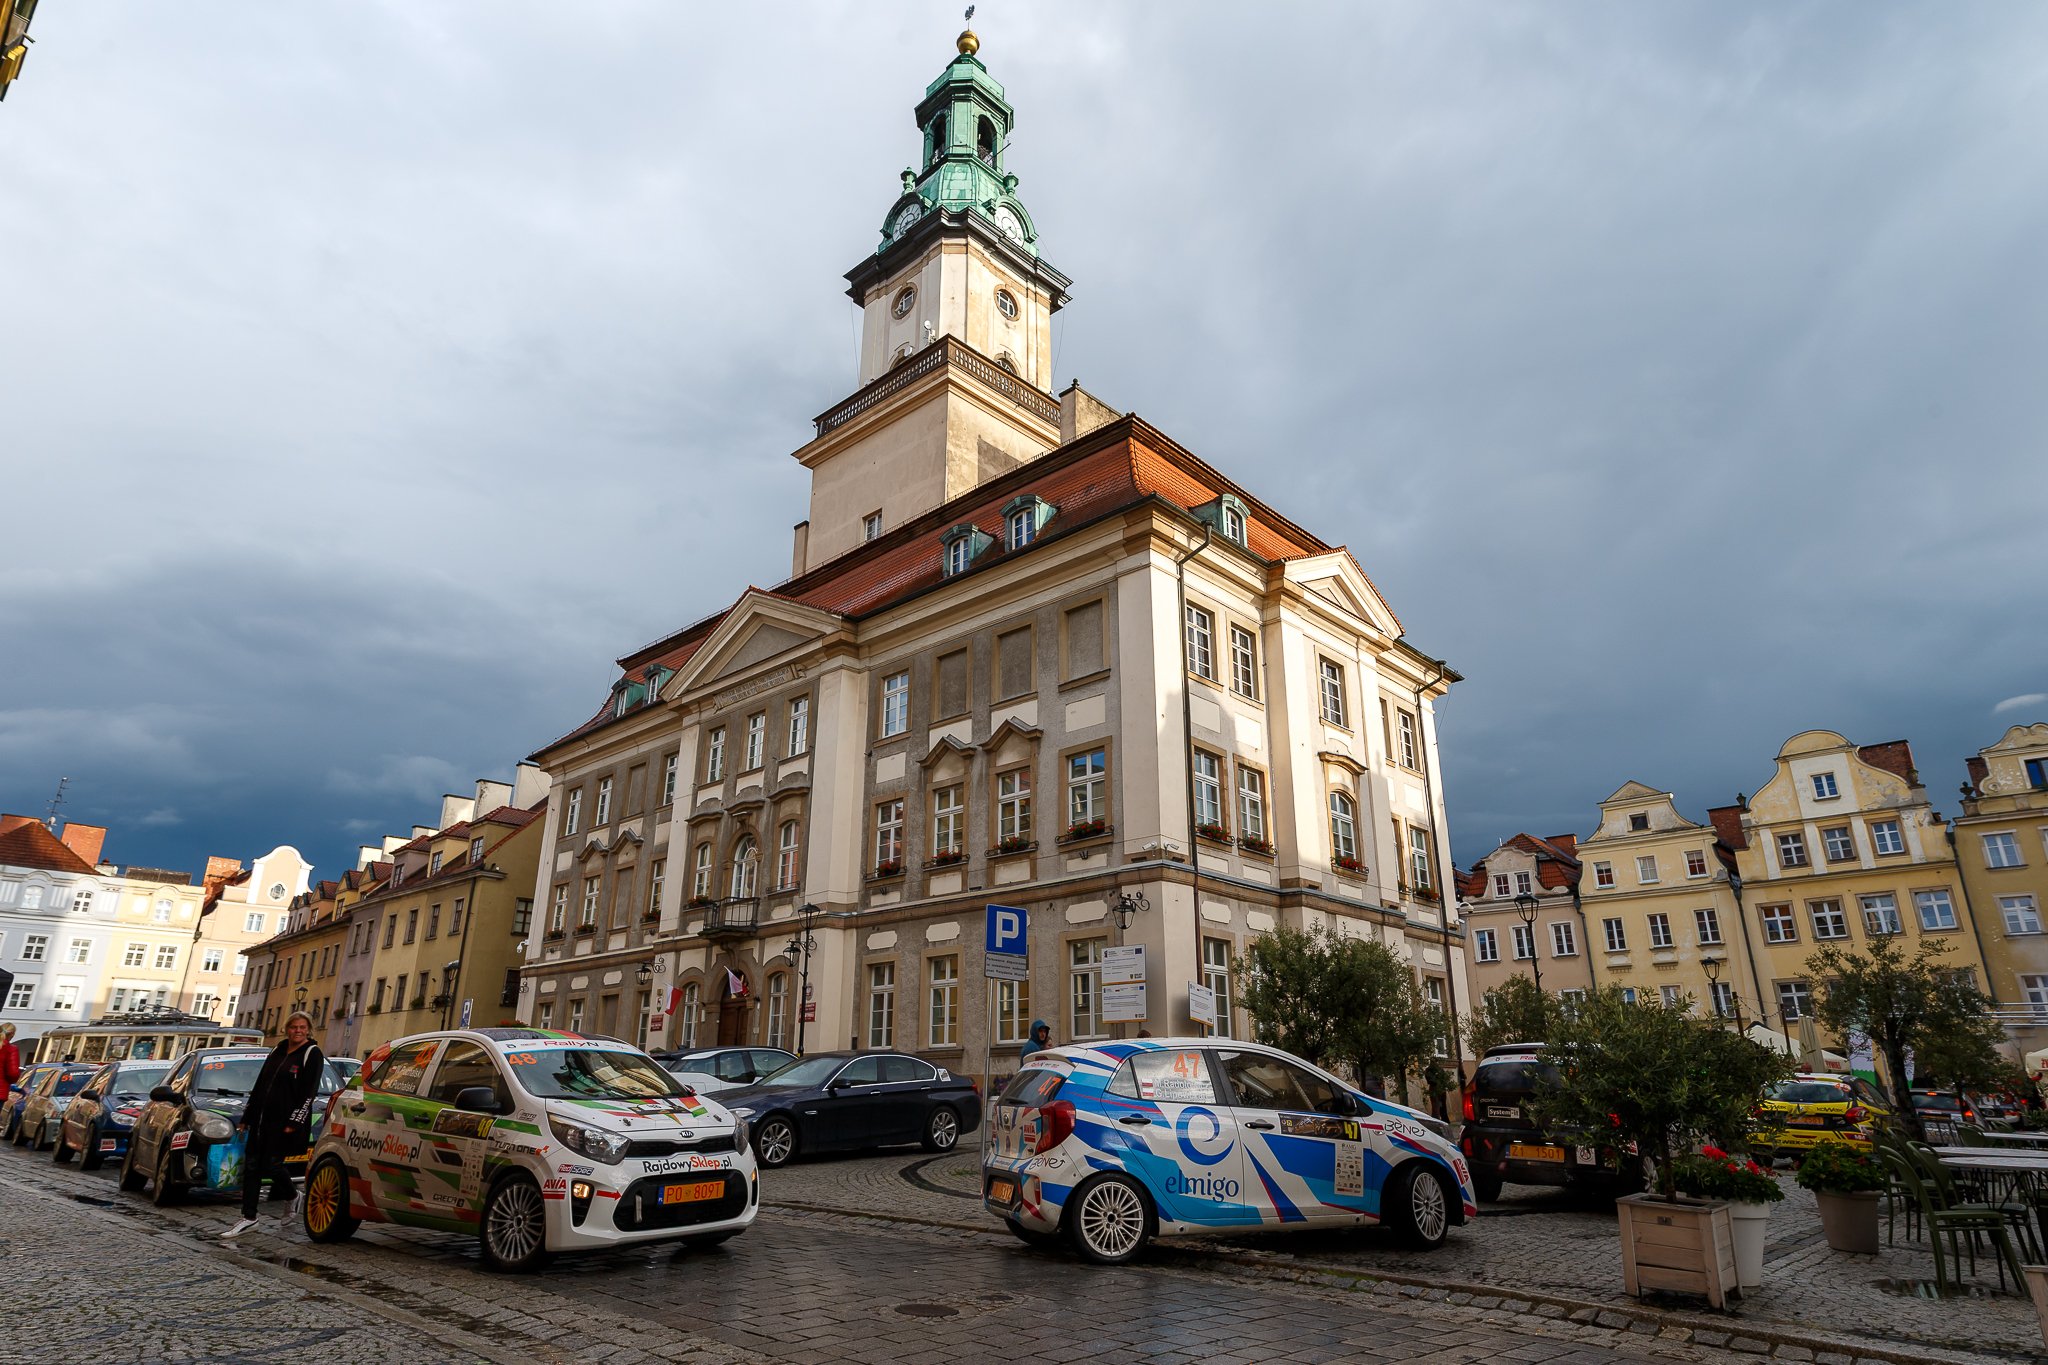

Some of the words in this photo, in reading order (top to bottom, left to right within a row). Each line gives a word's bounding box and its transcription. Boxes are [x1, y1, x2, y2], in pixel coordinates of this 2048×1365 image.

[996, 911, 1019, 948] P
[462, 1001, 470, 1019] P
[415, 1043, 440, 1069] 48
[509, 1053, 537, 1066] 48
[1173, 1052, 1200, 1078] 47
[203, 1062, 225, 1071] 49
[1038, 1077, 1061, 1096] 47
[173, 1132, 190, 1142] AVIA
[478, 1118, 494, 1138] 48
[681, 1130, 693, 1138] KIA
[1343, 1121, 1359, 1140] 47
[347, 1129, 423, 1162] RajdowySklep.pl
[1536, 1148, 1561, 1159] 1501
[643, 1156, 732, 1175] RajdowySklep.pl
[543, 1179, 567, 1189] AVIA
[694, 1182, 722, 1200] 809T
[1165, 1169, 1239, 1203] elmigo
